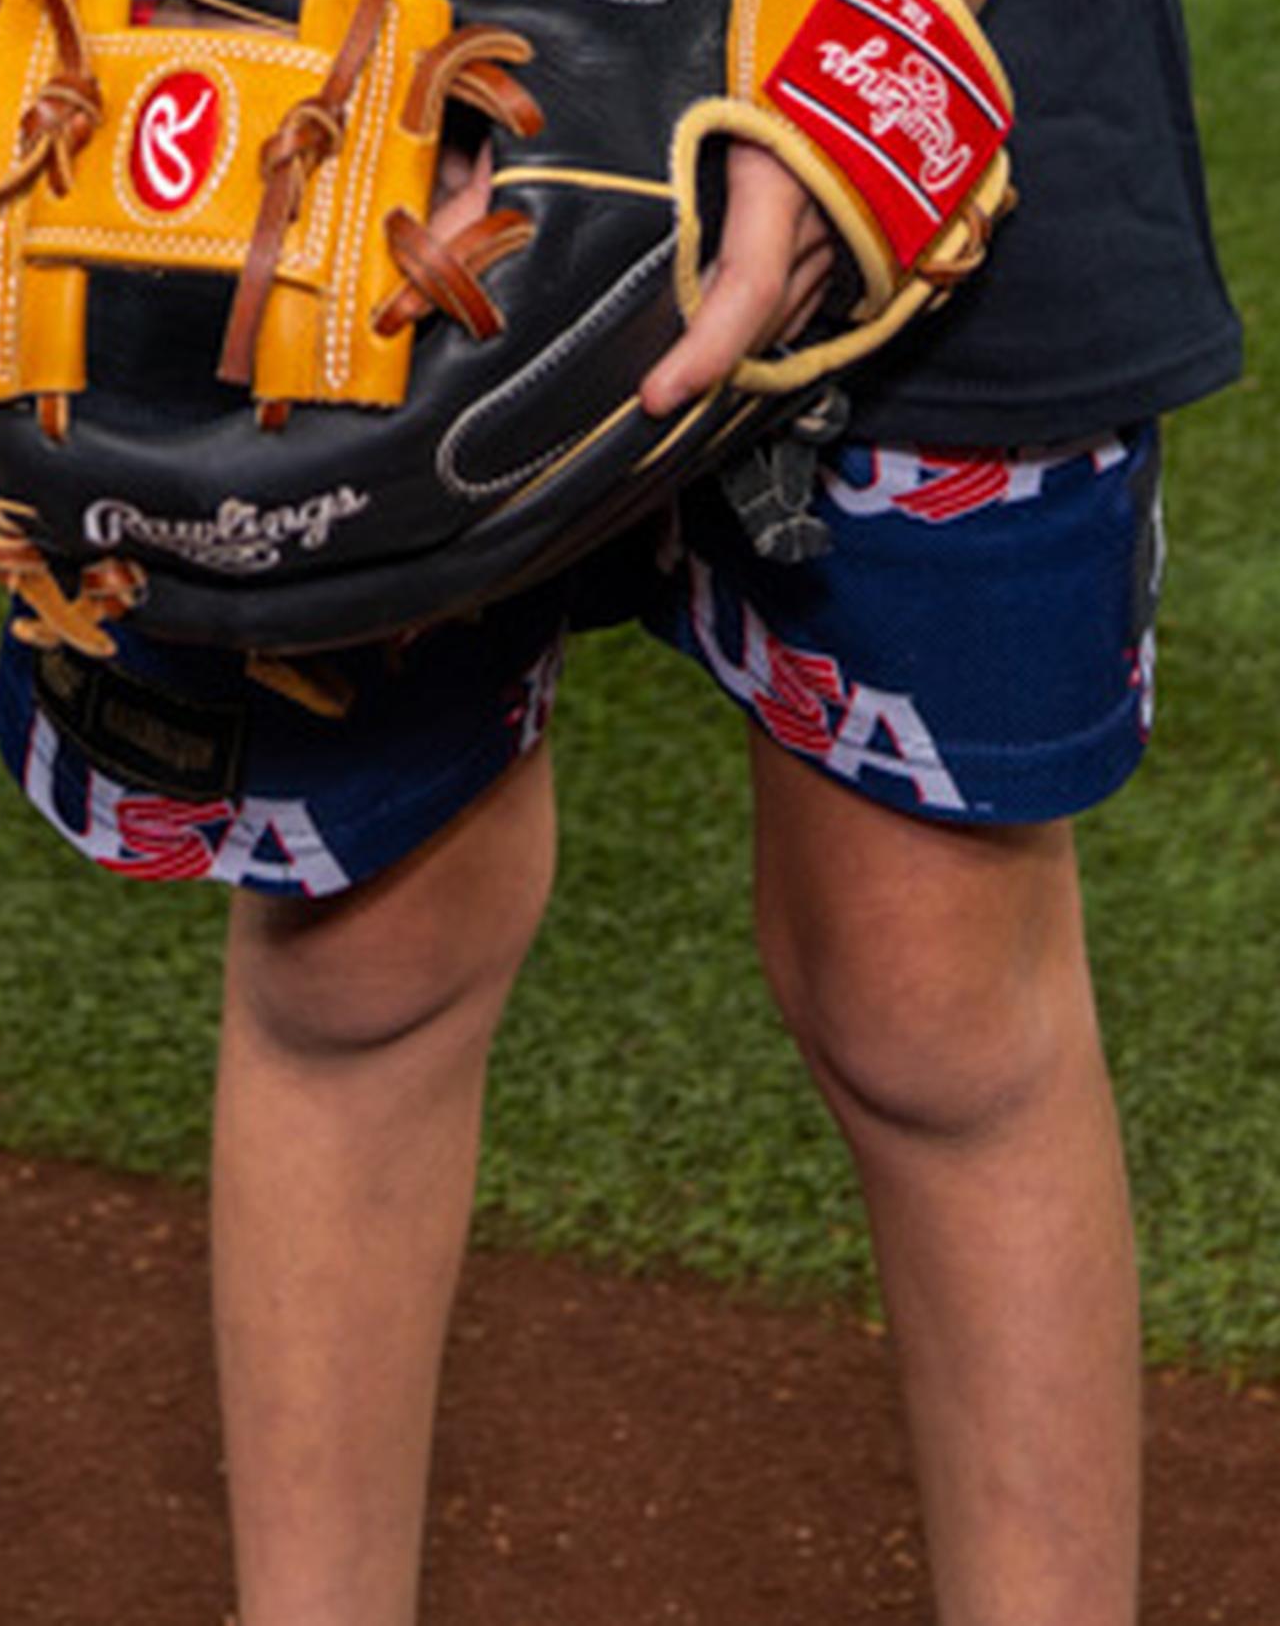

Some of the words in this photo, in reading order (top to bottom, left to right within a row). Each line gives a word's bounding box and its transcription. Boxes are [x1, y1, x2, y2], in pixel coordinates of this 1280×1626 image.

[83, 485, 371, 573] Rawlings
[690, 549, 970, 812] USA
[23, 707, 354, 899] USA
